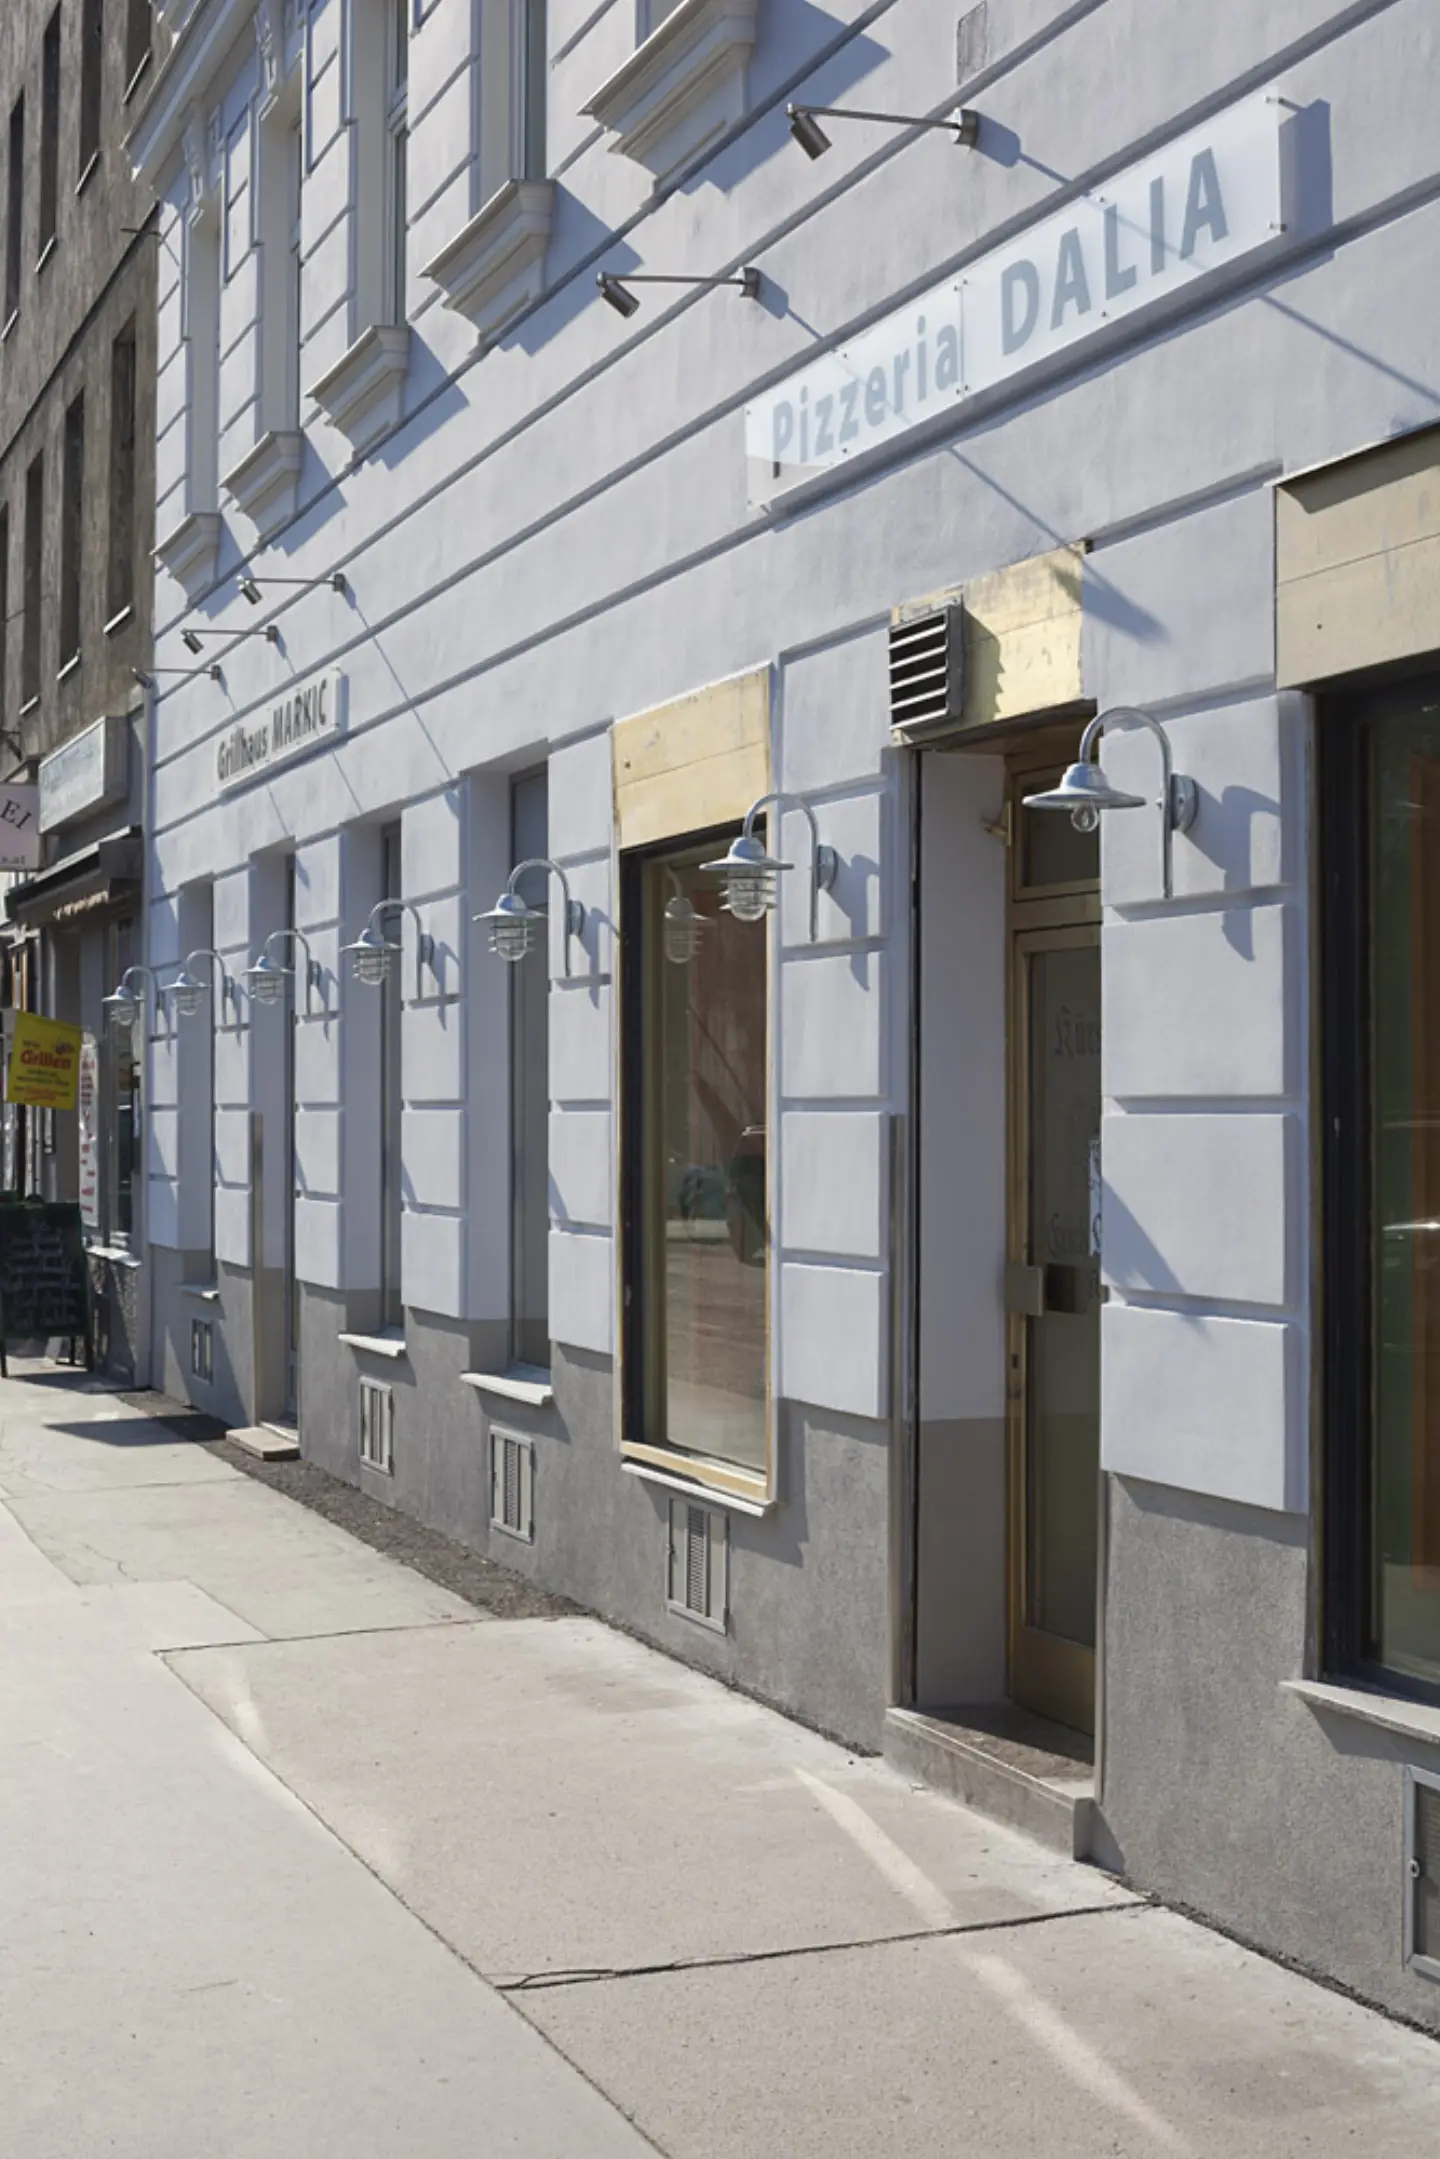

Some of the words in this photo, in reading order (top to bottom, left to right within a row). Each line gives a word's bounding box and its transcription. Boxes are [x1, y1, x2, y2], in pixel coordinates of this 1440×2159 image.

[771, 314, 960, 478] Pizzeria
[1000, 144, 1230, 357] DALIA
[217, 725, 268, 781] Grillhaus
